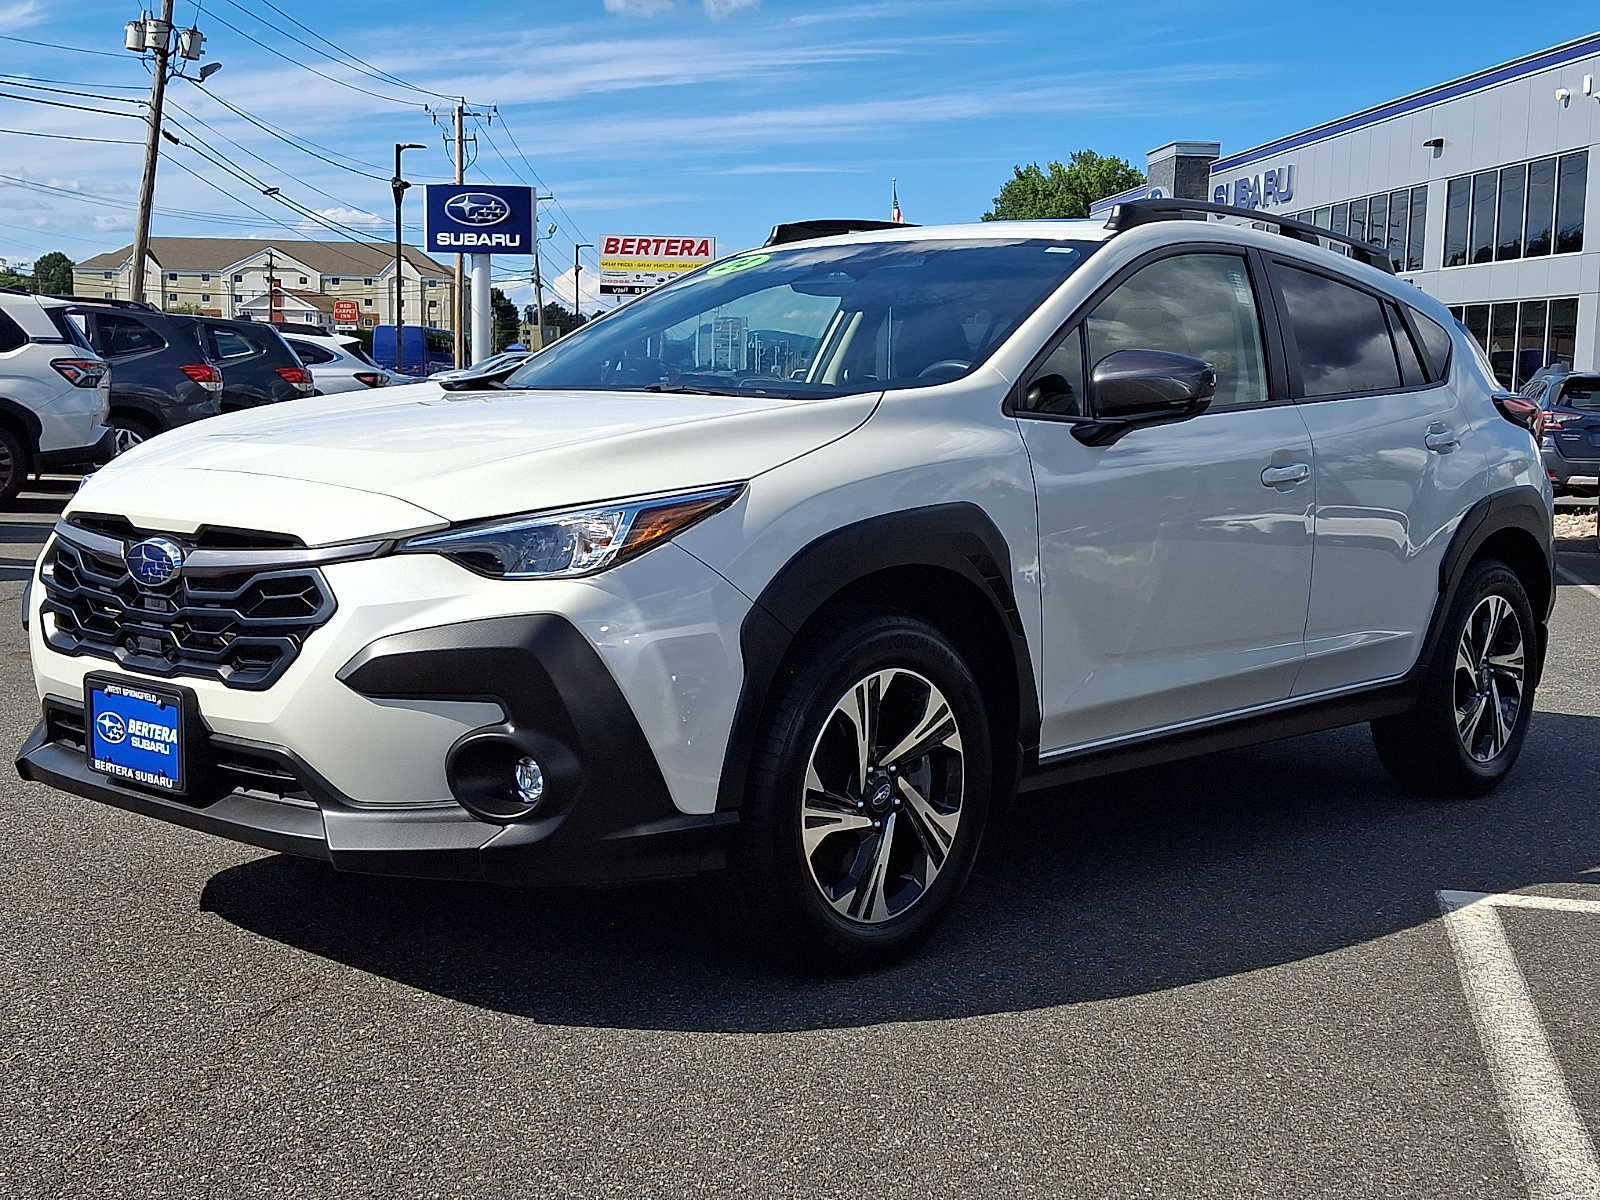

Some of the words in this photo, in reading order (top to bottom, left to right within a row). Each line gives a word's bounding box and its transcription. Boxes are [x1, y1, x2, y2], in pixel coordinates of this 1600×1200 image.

[1214, 165, 1295, 210] SUBARU
[436, 232, 520, 247] SUBARU
[603, 237, 710, 257] BERTERA
[106, 685, 122, 694] WEST
[122, 688, 157, 703] SPRINGFIELD
[128, 719, 178, 744] BERTERA
[131, 736, 170, 755] SUBARU
[94, 760, 134, 779] BERTERA
[134, 770, 173, 788] SUBARU
